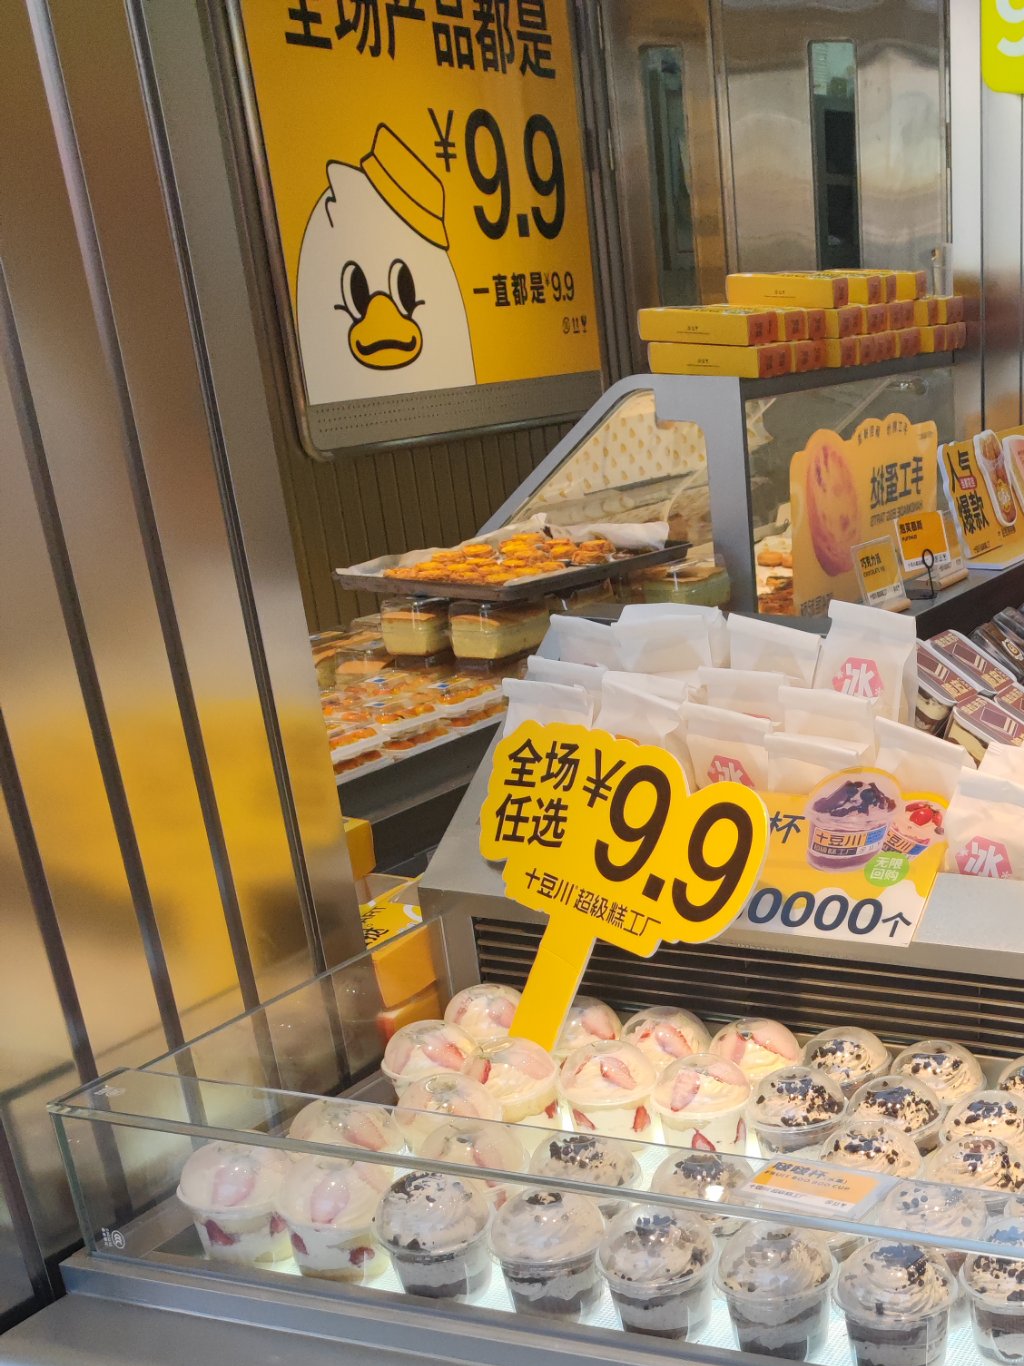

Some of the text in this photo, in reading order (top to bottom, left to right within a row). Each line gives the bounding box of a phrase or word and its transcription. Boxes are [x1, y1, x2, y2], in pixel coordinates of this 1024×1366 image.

[428, 108, 566, 240] ¥9.9
[842, 660, 875, 697] 冰
[504, 738, 580, 792] 全场
[494, 793, 569, 847] 任选
[582, 748, 753, 923] ¥9.9
[965, 841, 1004, 879] 冰
[739, 887, 912, 937] 0000个
